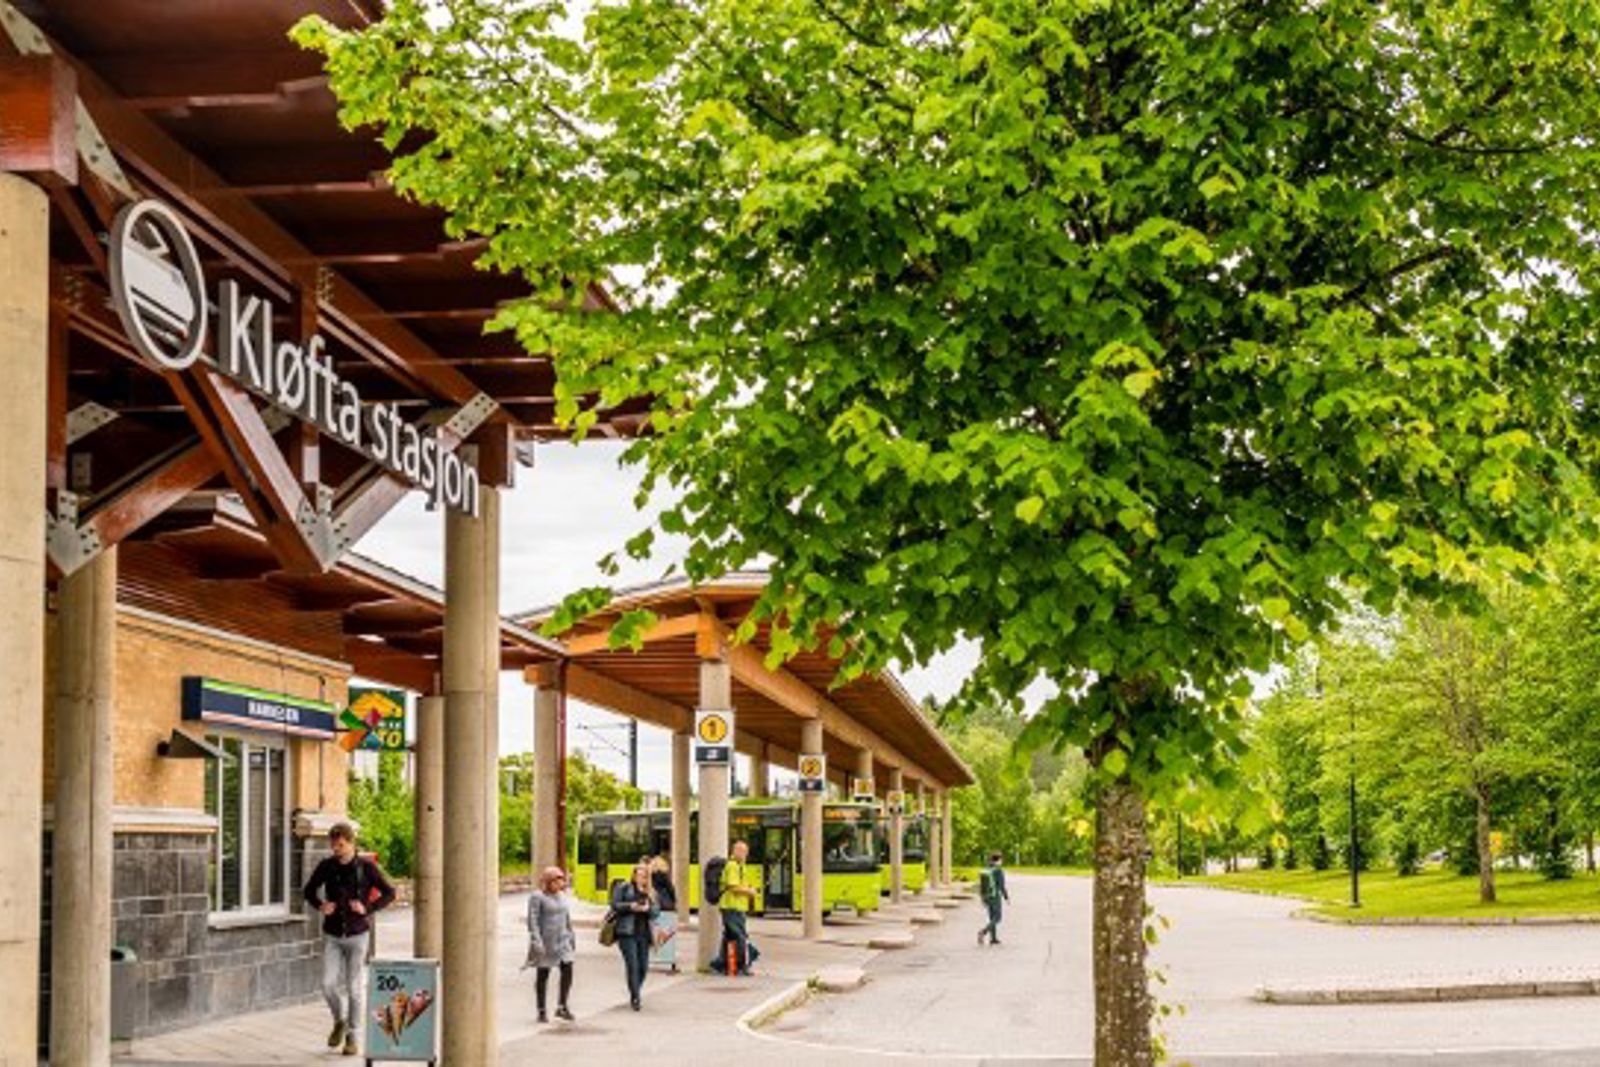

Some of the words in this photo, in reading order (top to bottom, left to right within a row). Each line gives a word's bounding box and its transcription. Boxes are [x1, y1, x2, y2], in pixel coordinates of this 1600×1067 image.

[223, 279, 361, 446] Kløfta
[372, 403, 479, 518] stasjon
[706, 719, 717, 738] 1
